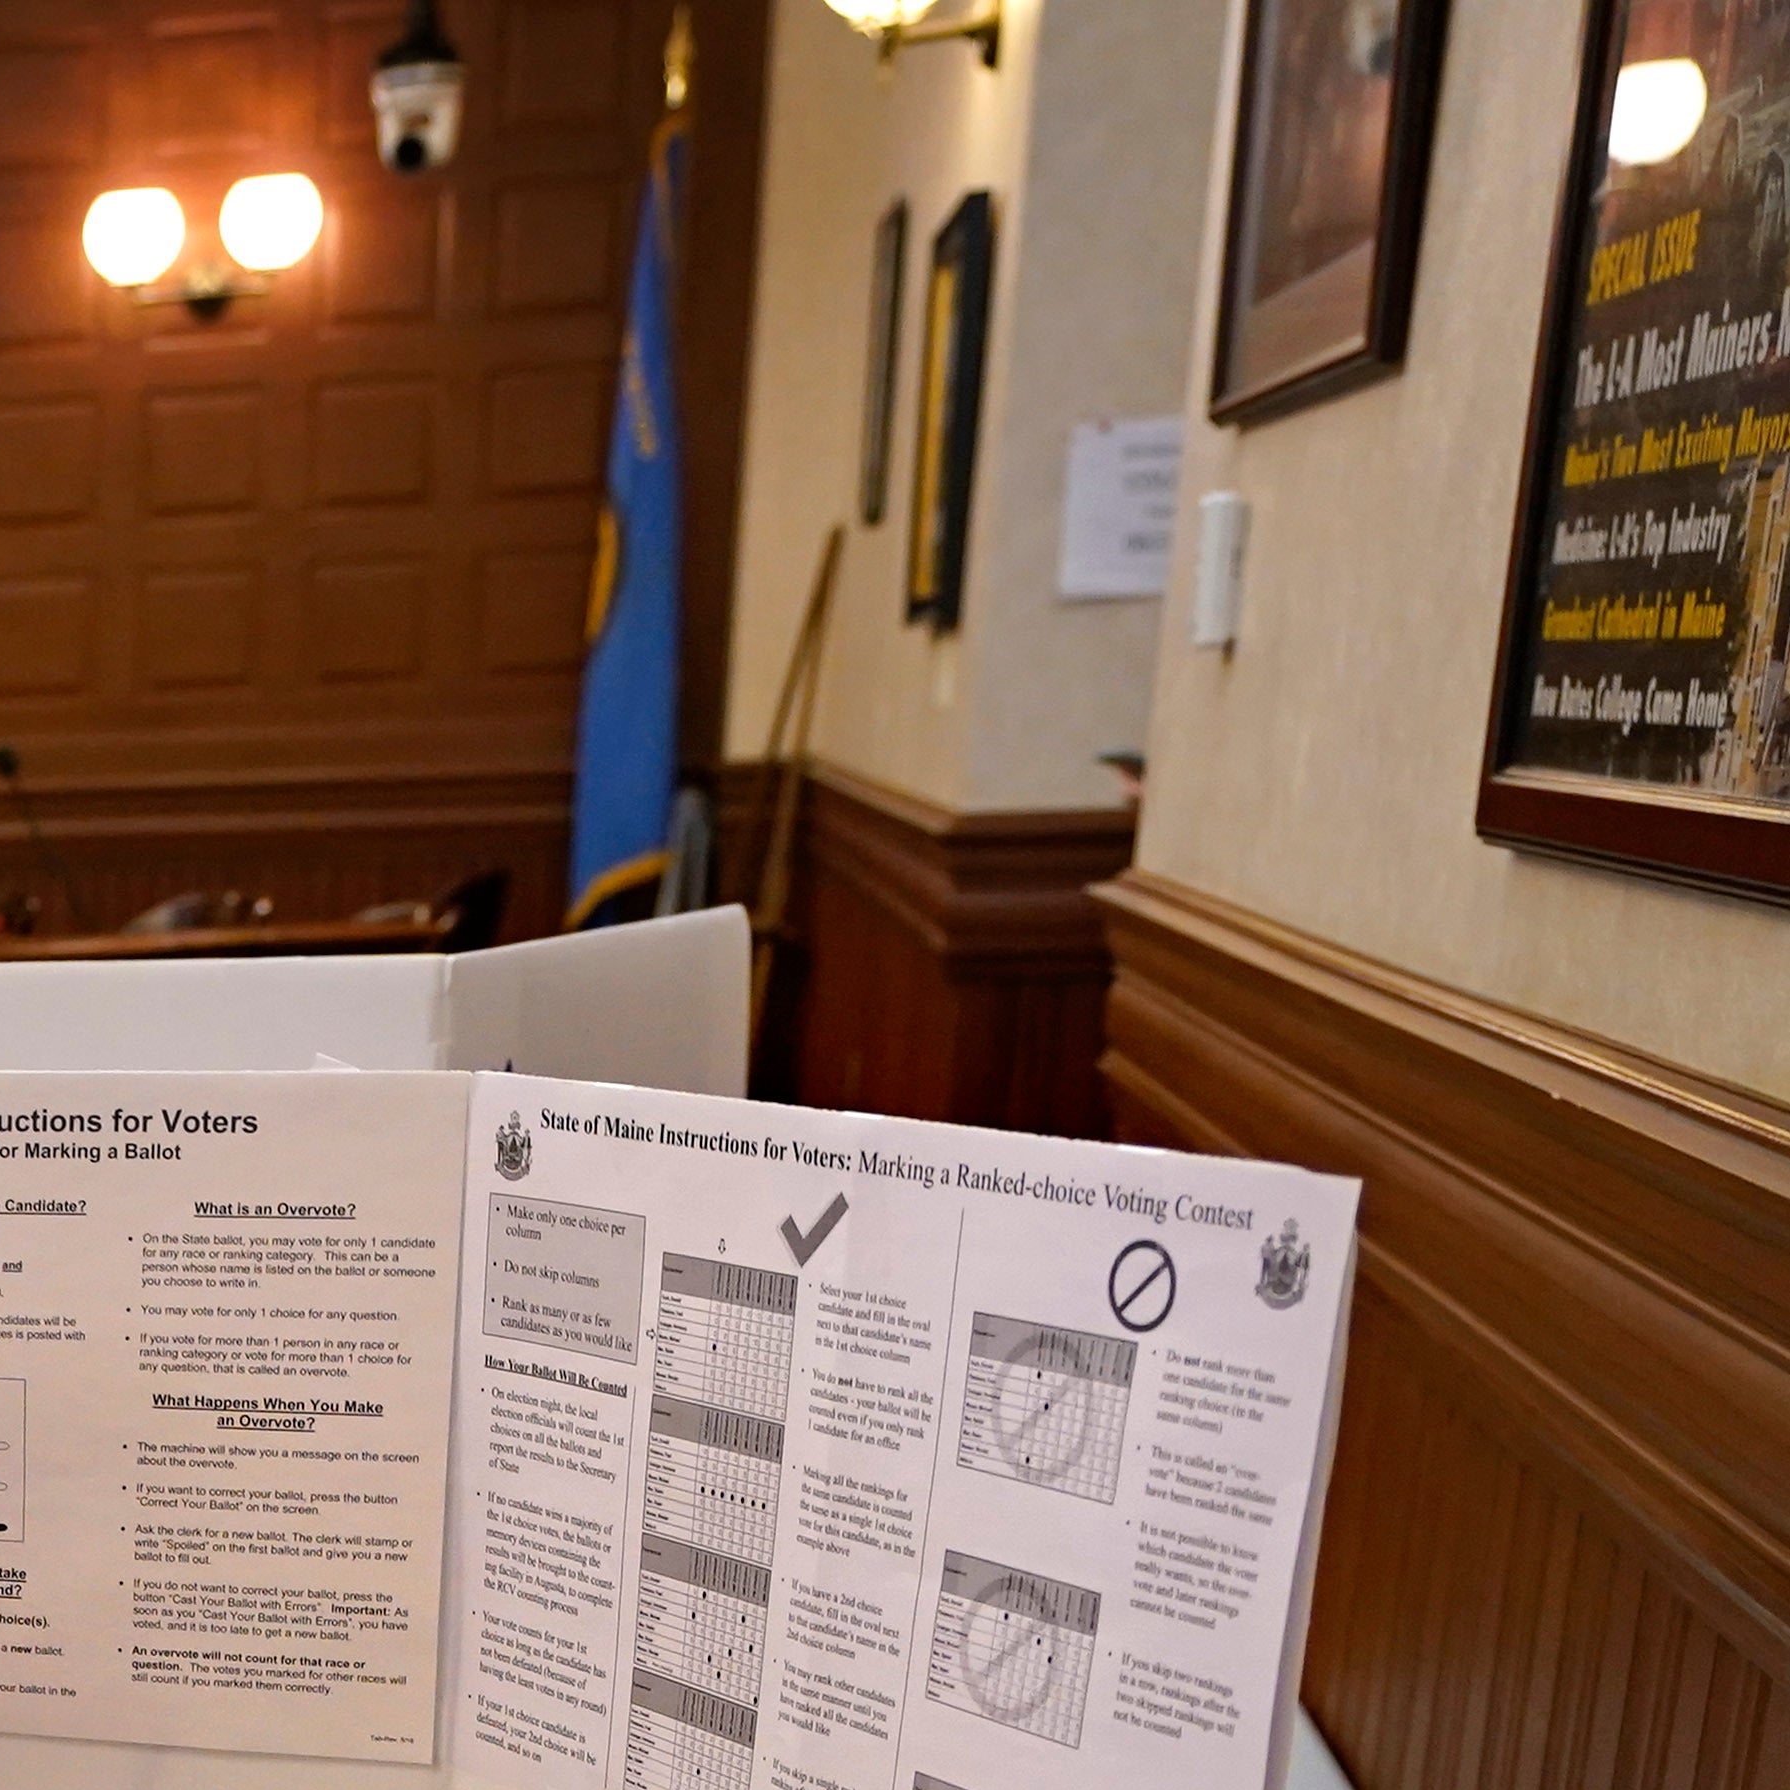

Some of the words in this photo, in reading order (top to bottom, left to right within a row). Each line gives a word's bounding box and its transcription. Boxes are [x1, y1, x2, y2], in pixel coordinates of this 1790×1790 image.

[1586, 231, 1648, 306] SPECIAL
[1649, 208, 1701, 283] ISSUE
[111, 1108, 153, 1132] for
[161, 1109, 257, 1133] Voters
[25, 1142, 100, 1163] Marking
[107, 1146, 117, 1159] a
[125, 1142, 181, 1160] Ballot
[540, 1107, 579, 1132] State
[583, 1114, 601, 1135] of
[604, 1115, 653, 1142] Maine
[659, 1123, 757, 1156] Instructions
[763, 1136, 787, 1160] for
[792, 1140, 851, 1171] Voters:
[858, 1150, 934, 1189] Marking
[940, 1168, 949, 1184] a
[956, 1163, 1095, 1206] Ranked-choice
[1105, 1184, 1167, 1223] Voting
[1175, 1195, 1251, 1228] Contest
[4, 1198, 86, 1212] Candidate?
[506, 1203, 534, 1220] Make
[536, 1209, 557, 1227] only
[559, 1215, 576, 1227] one
[578, 1215, 609, 1232] choice
[610, 1223, 625, 1237] per
[505, 1223, 541, 1240] column
[504, 1258, 519, 1273] Do
[521, 1265, 536, 1276] not
[538, 1265, 558, 1283] skip
[560, 1270, 599, 1288] columns
[502, 1295, 527, 1312] Rank
[529, 1303, 540, 1314] as
[541, 1305, 568, 1322] many
[569, 1311, 580, 1322] or
[581, 1313, 592, 1324] as
[594, 1312, 611, 1327] few
[500, 1316, 550, 1335] candidates
[552, 1326, 562, 1337] as
[564, 1328, 582, 1342] you
[584, 1332, 613, 1348] would
[614, 1335, 632, 1352] like
